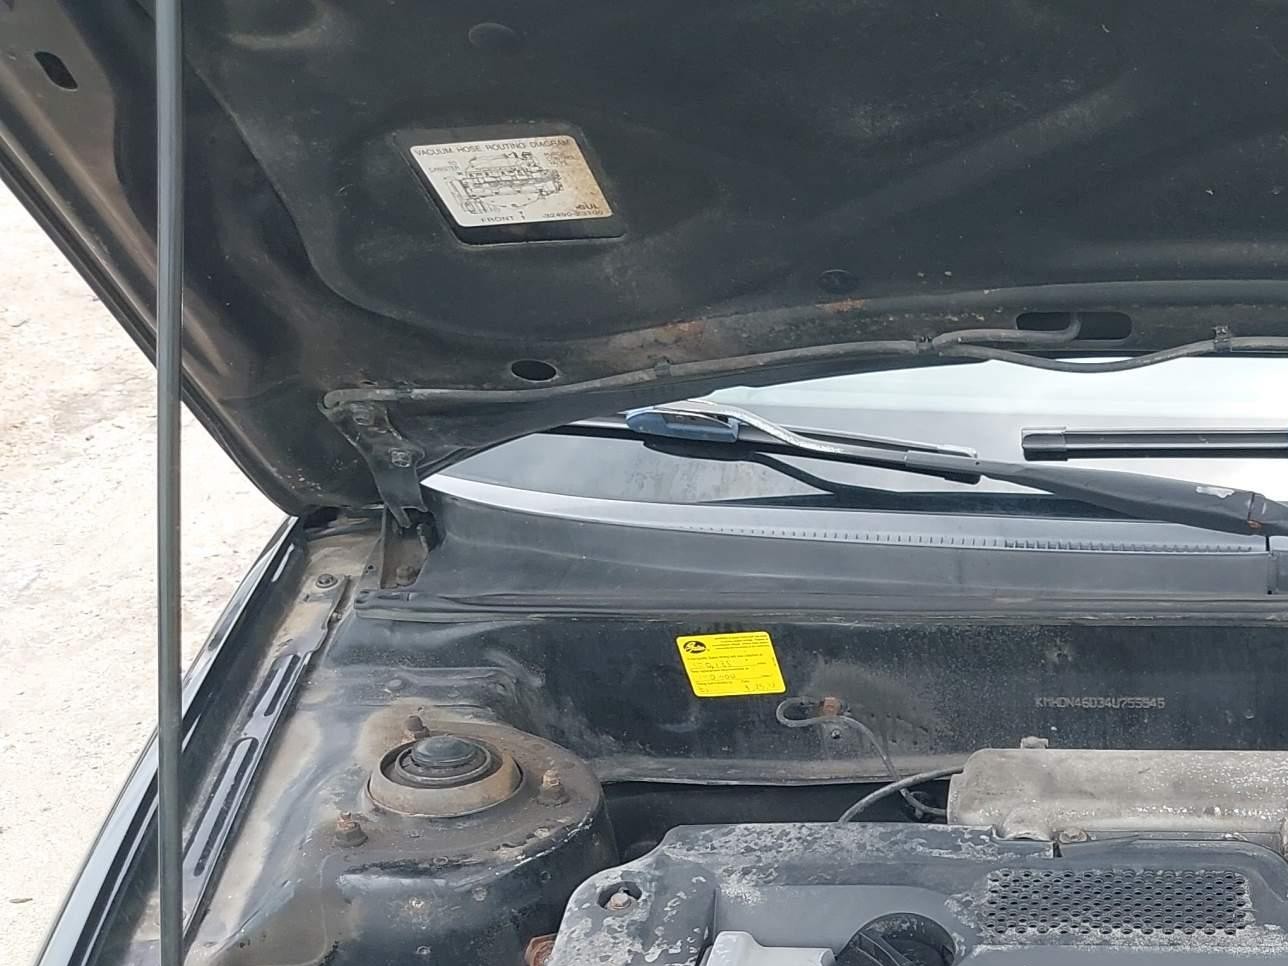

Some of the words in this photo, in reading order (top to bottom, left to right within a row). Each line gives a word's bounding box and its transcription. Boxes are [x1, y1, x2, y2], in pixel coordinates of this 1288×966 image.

[415, 146, 453, 157] VACUUM
[458, 144, 481, 153] HOSE
[485, 141, 526, 152] ROUTING
